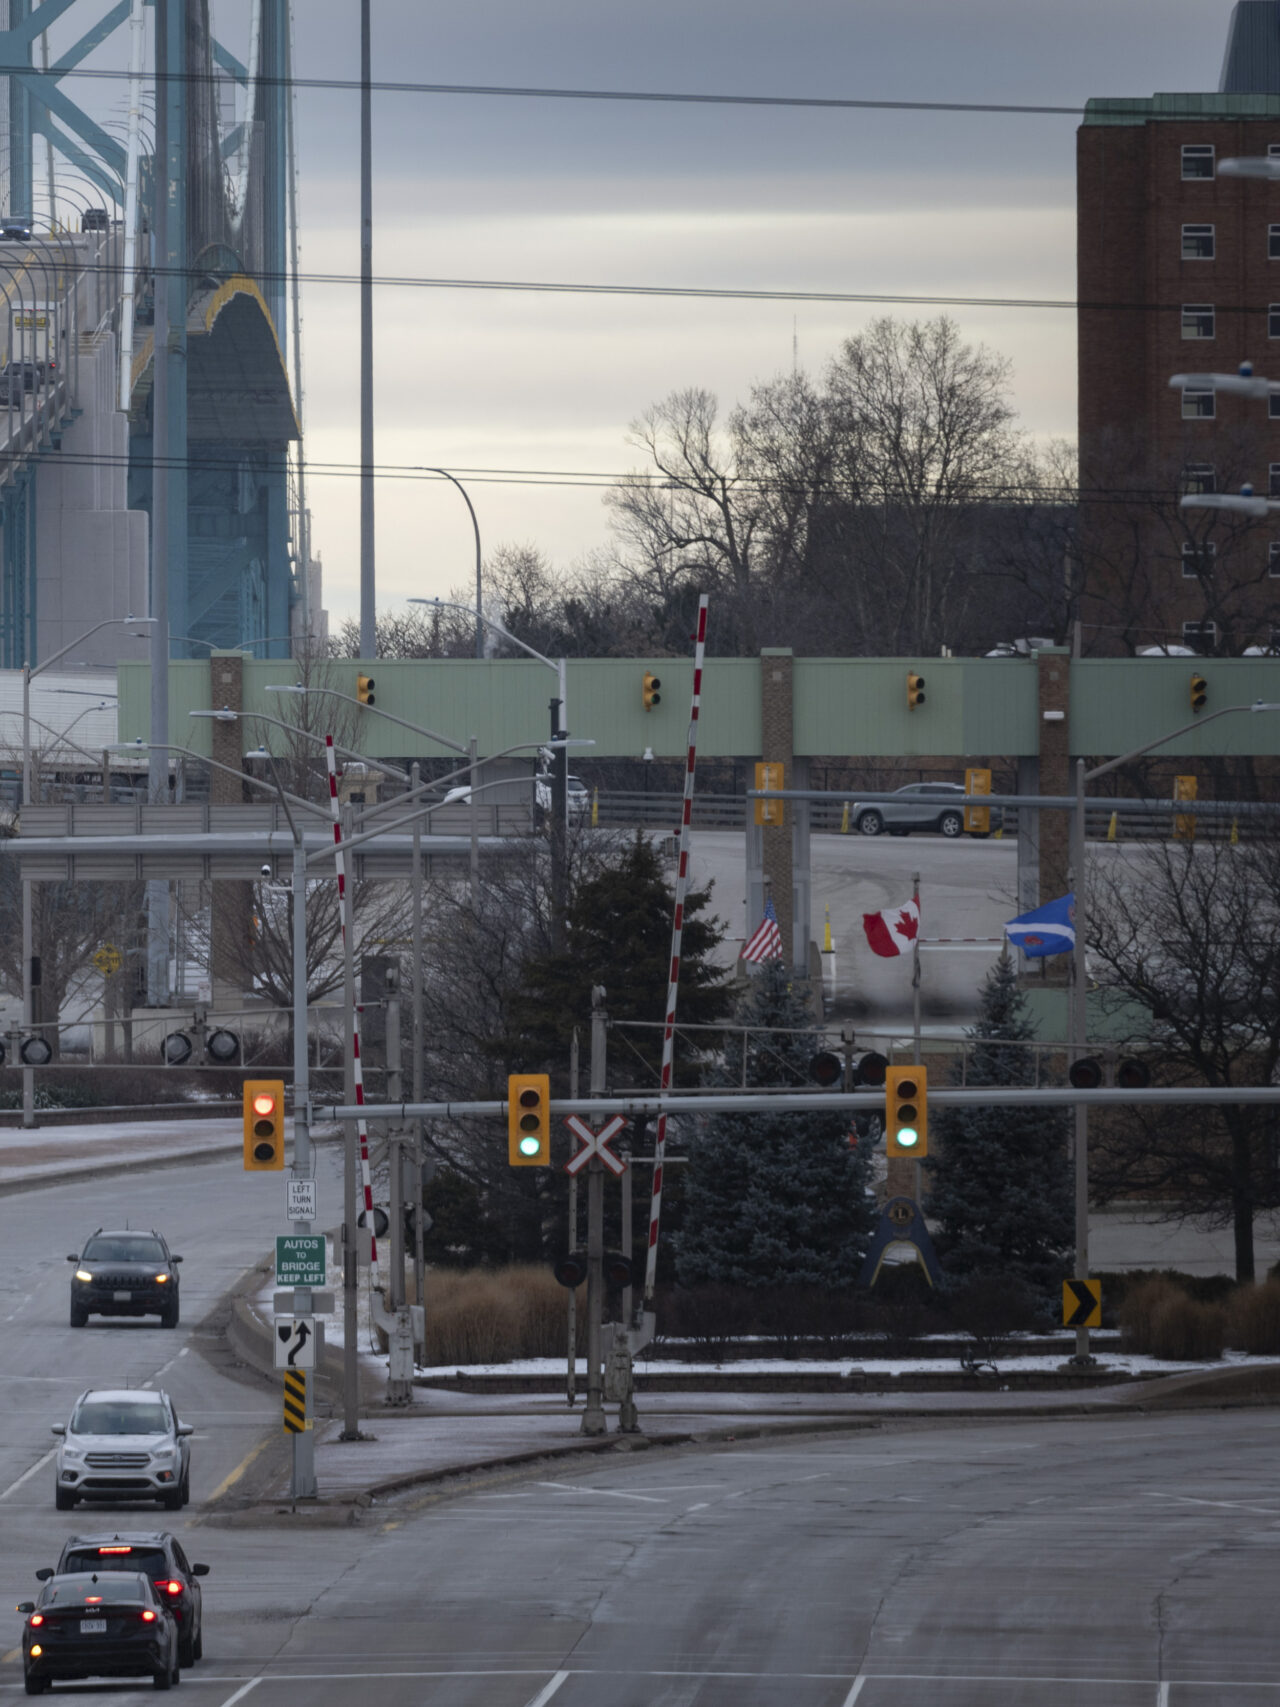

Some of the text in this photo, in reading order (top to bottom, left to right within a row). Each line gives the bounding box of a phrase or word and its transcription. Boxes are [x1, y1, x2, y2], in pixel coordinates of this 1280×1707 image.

[292, 1185, 310, 1193] LEFT
[292, 1195, 311, 1203] TURN
[288, 1206, 314, 1214] SIGNAL
[284, 1240, 319, 1249] AUTOS
[296, 1251, 306, 1259] TO
[281, 1262, 320, 1271] BRIDGE
[277, 1274, 324, 1283] KEEP LEFT
